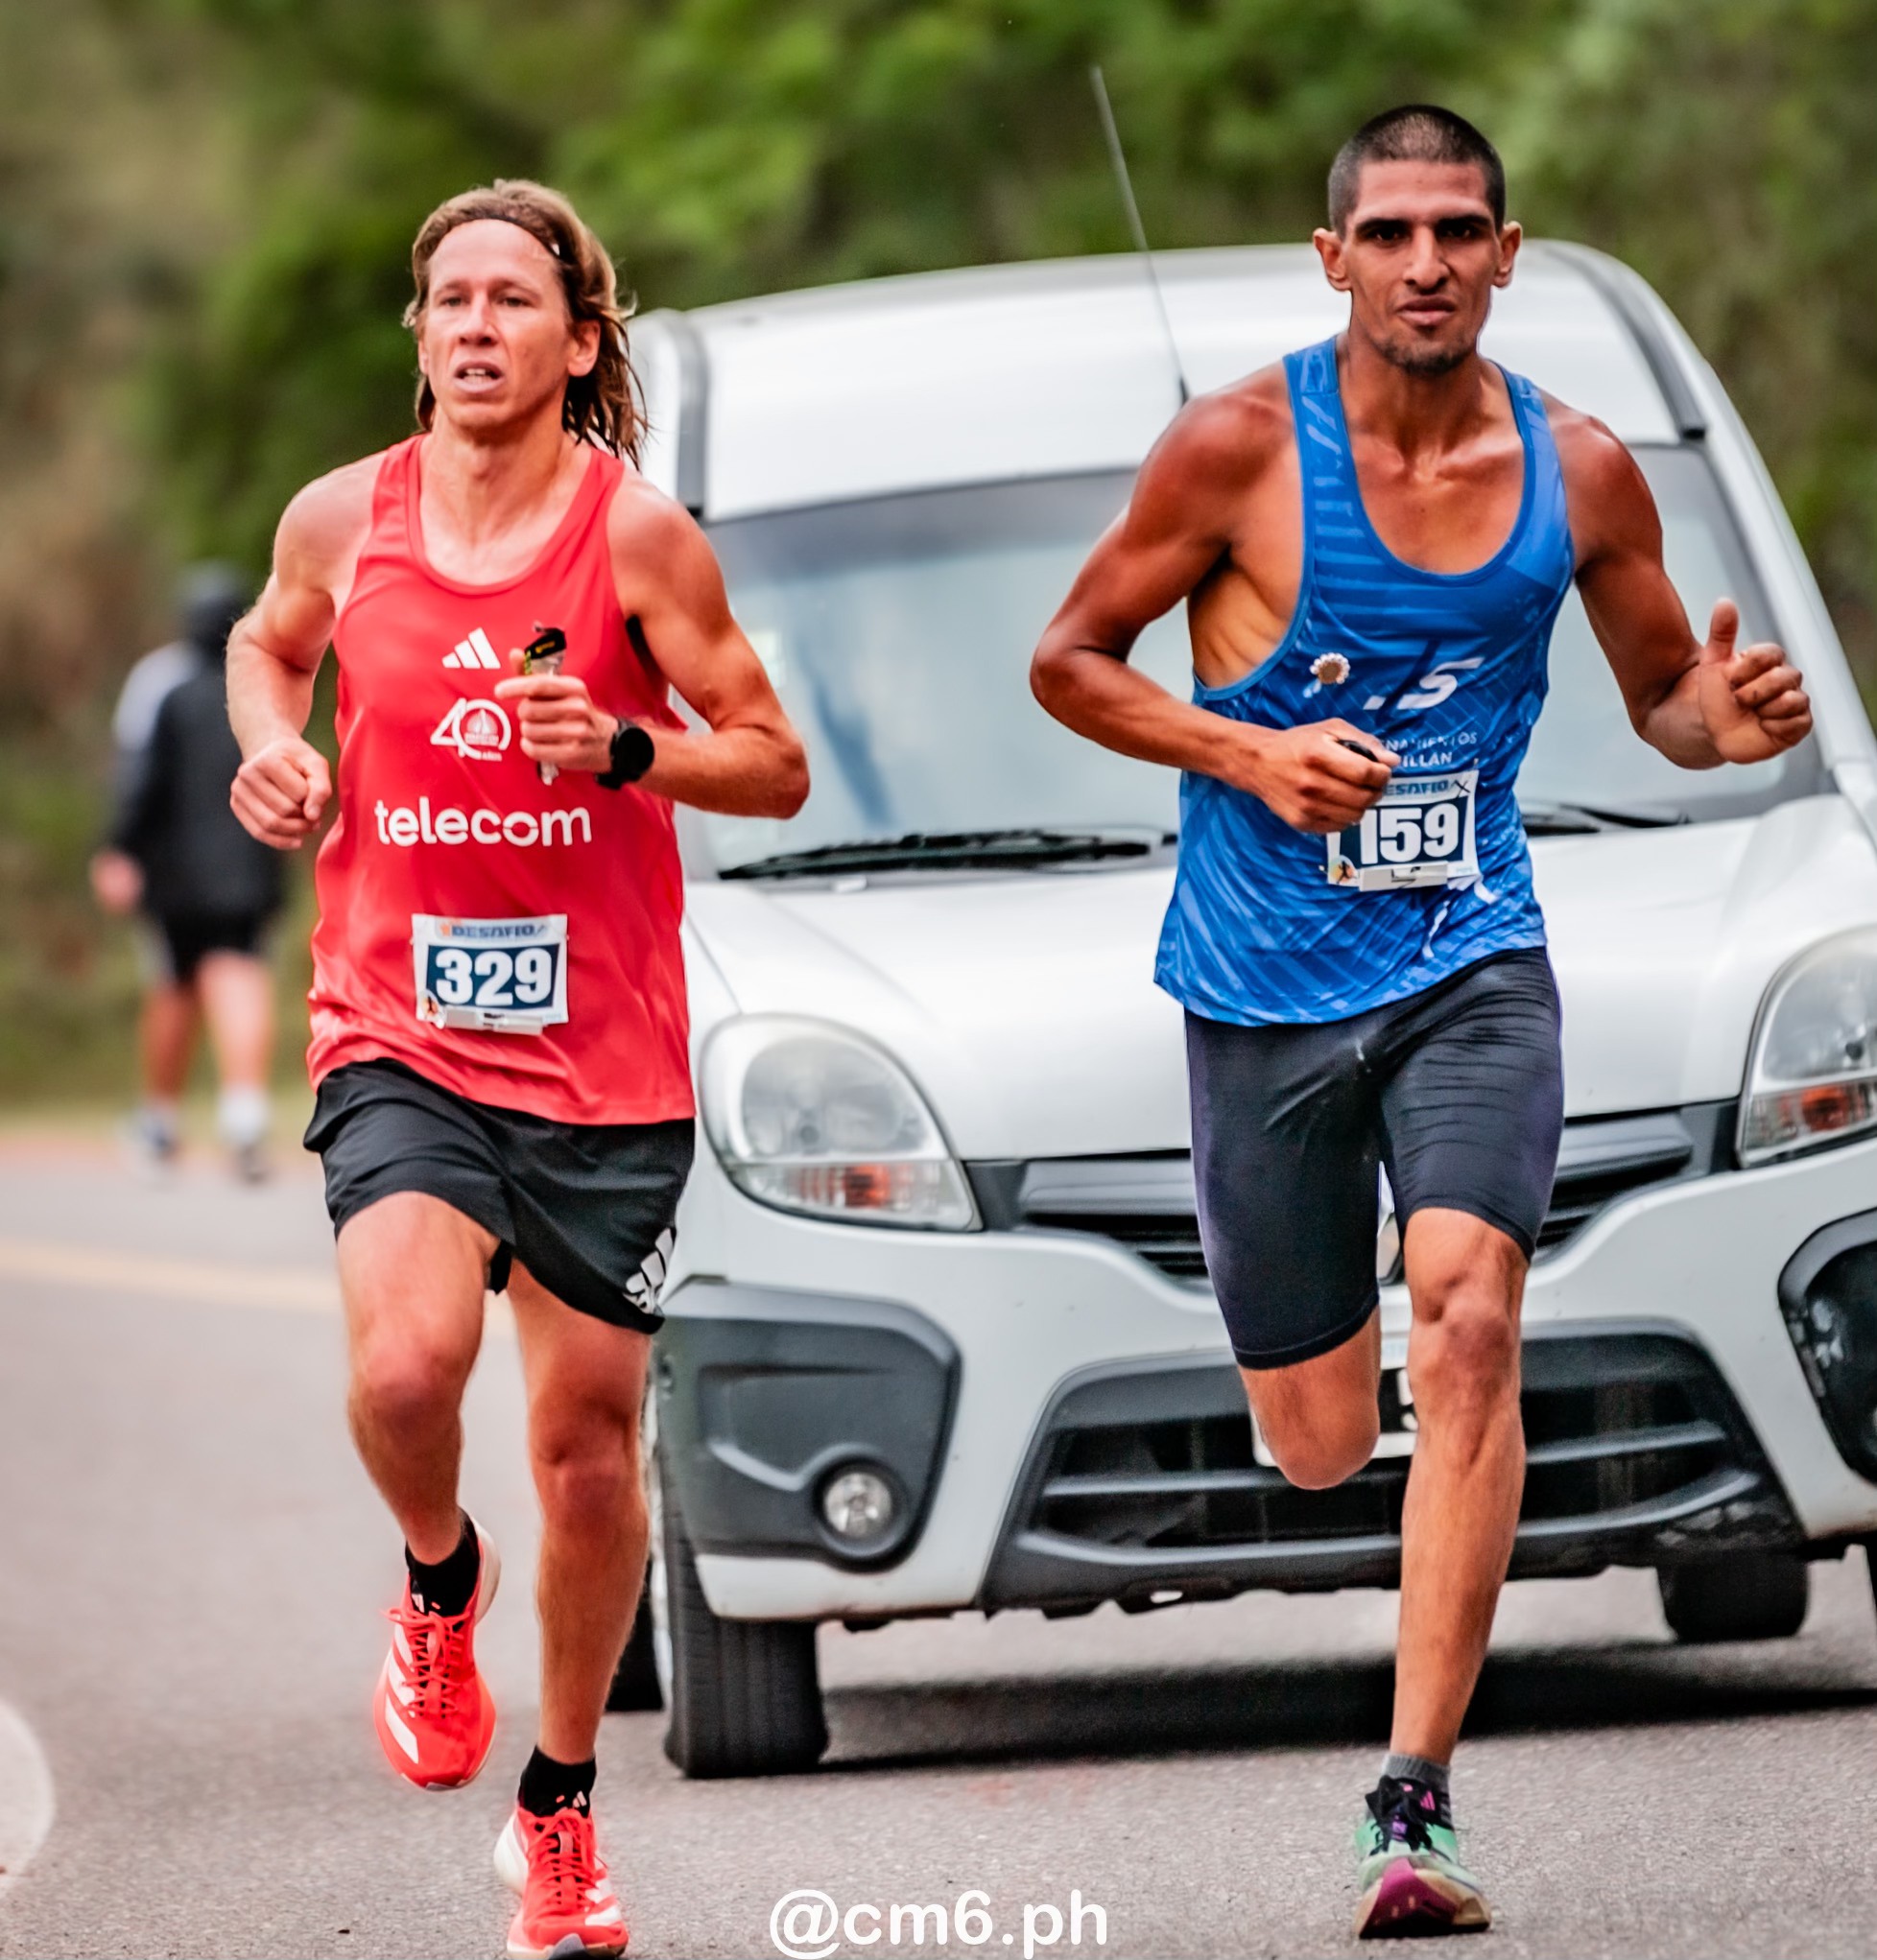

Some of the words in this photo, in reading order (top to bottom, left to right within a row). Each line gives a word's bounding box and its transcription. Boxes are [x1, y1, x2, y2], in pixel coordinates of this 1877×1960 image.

[430, 697, 511, 760] 40
[1402, 752, 1453, 767] ILLAN
[1384, 780, 1449, 796] ESAFIO
[374, 796, 592, 847] telecom
[1360, 803, 1460, 865] 159
[435, 947, 552, 1006] 329
